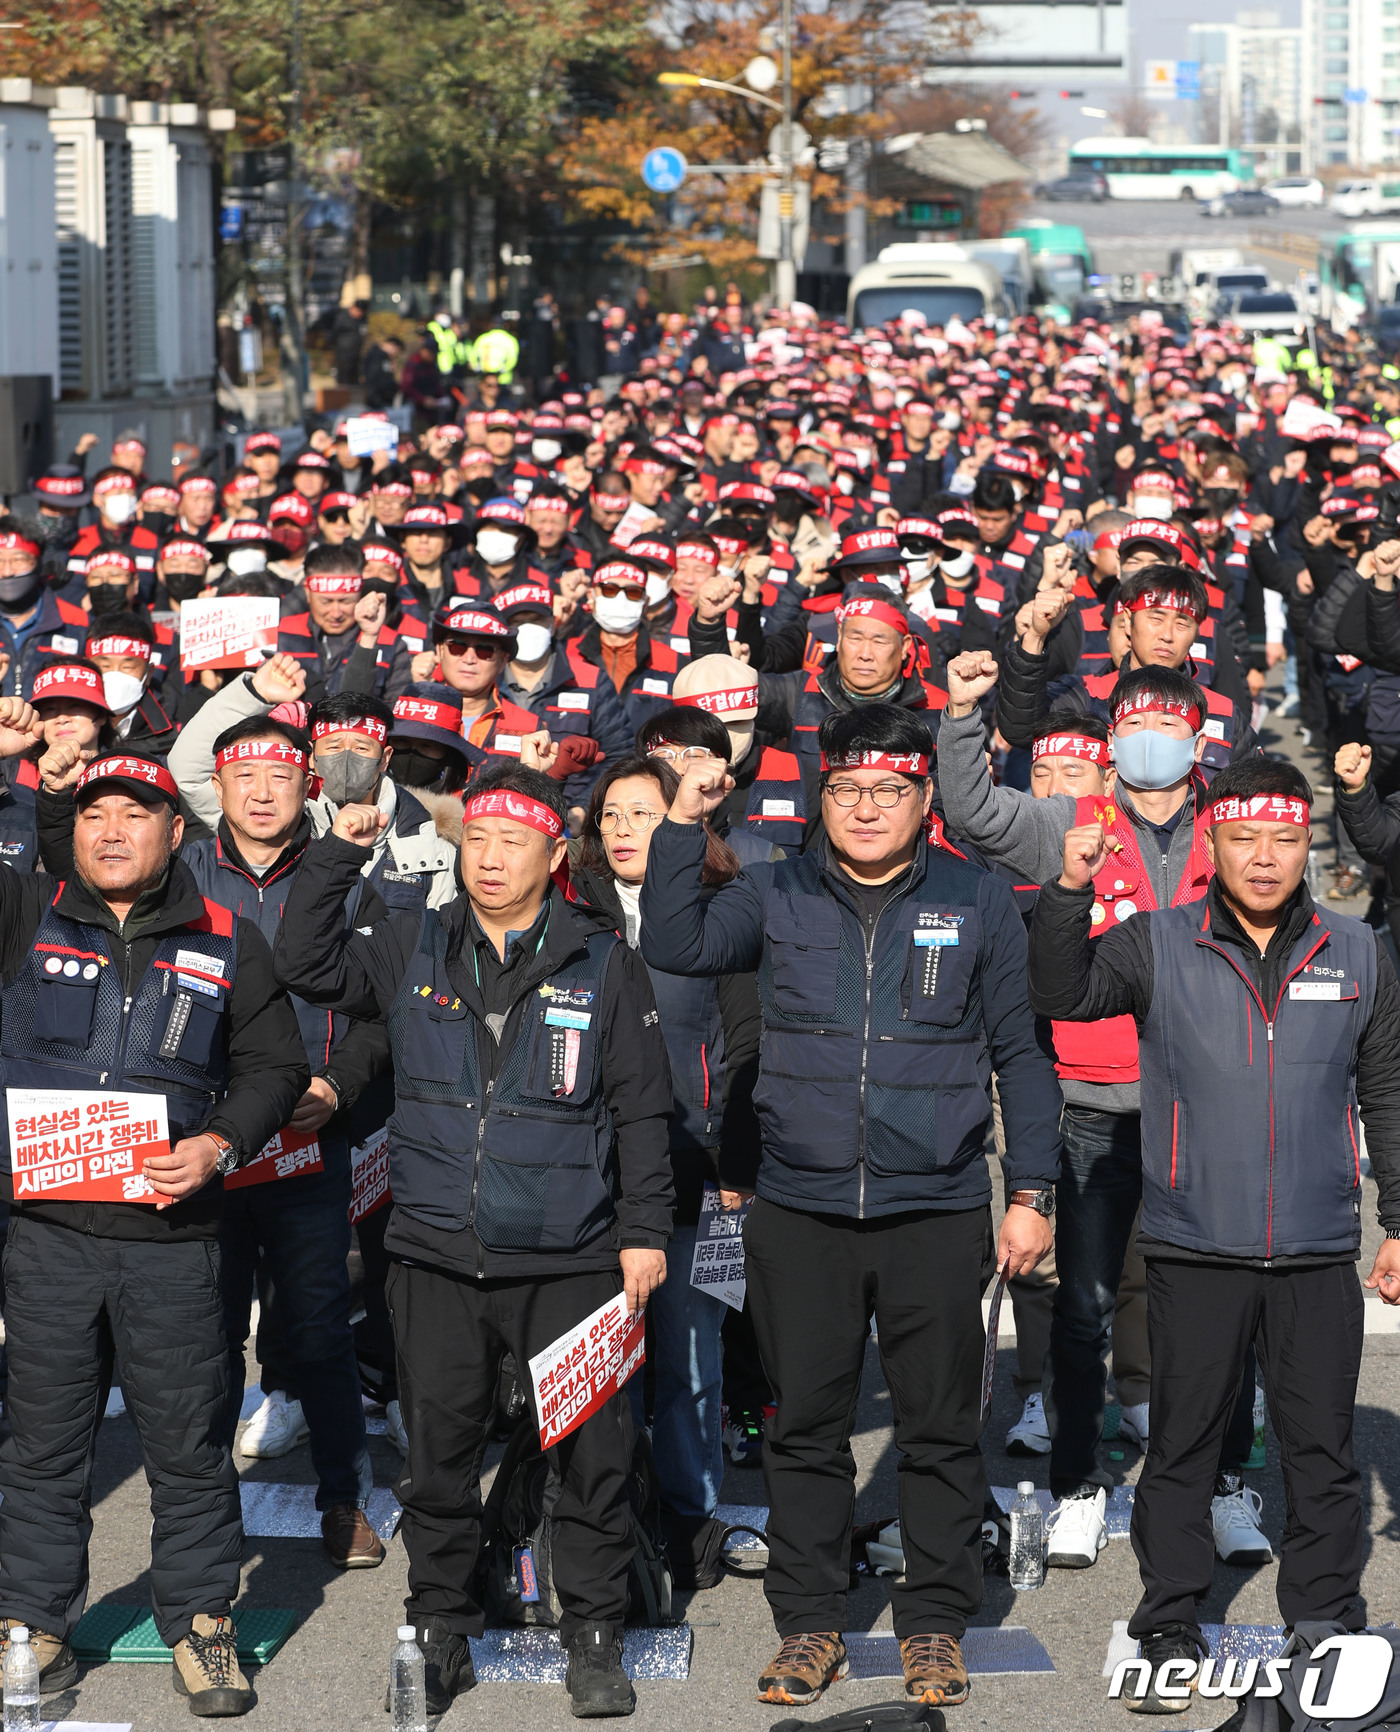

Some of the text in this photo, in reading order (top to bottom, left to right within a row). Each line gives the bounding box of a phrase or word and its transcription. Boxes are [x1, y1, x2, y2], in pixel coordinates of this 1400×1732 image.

[67, 667, 96, 687] 투쟁
[404, 700, 438, 720] 투쟁
[695, 692, 728, 712] 단결
[361, 717, 386, 742] 투쟁
[1068, 737, 1101, 761] 투쟁
[123, 759, 158, 783] 투쟁
[470, 793, 560, 833] 단결 투쟁
[1212, 796, 1304, 823] 단결 투쟁
[1313, 966, 1345, 978] 민주노총
[15, 1099, 130, 1141] 현실성 있는
[16, 1119, 159, 1168] 배차시간 쟁취!
[274, 1141, 321, 1178] 쟁취!
[17, 1149, 134, 1195] 시민의 안전
[538, 1337, 588, 1401] 현실성
[589, 1305, 622, 1349] 있는
[615, 1336, 646, 1389] 쟁취!
[541, 1344, 606, 1423] 배차시간
[544, 1380, 593, 1446] 시민의
[594, 1345, 625, 1394] 안전
